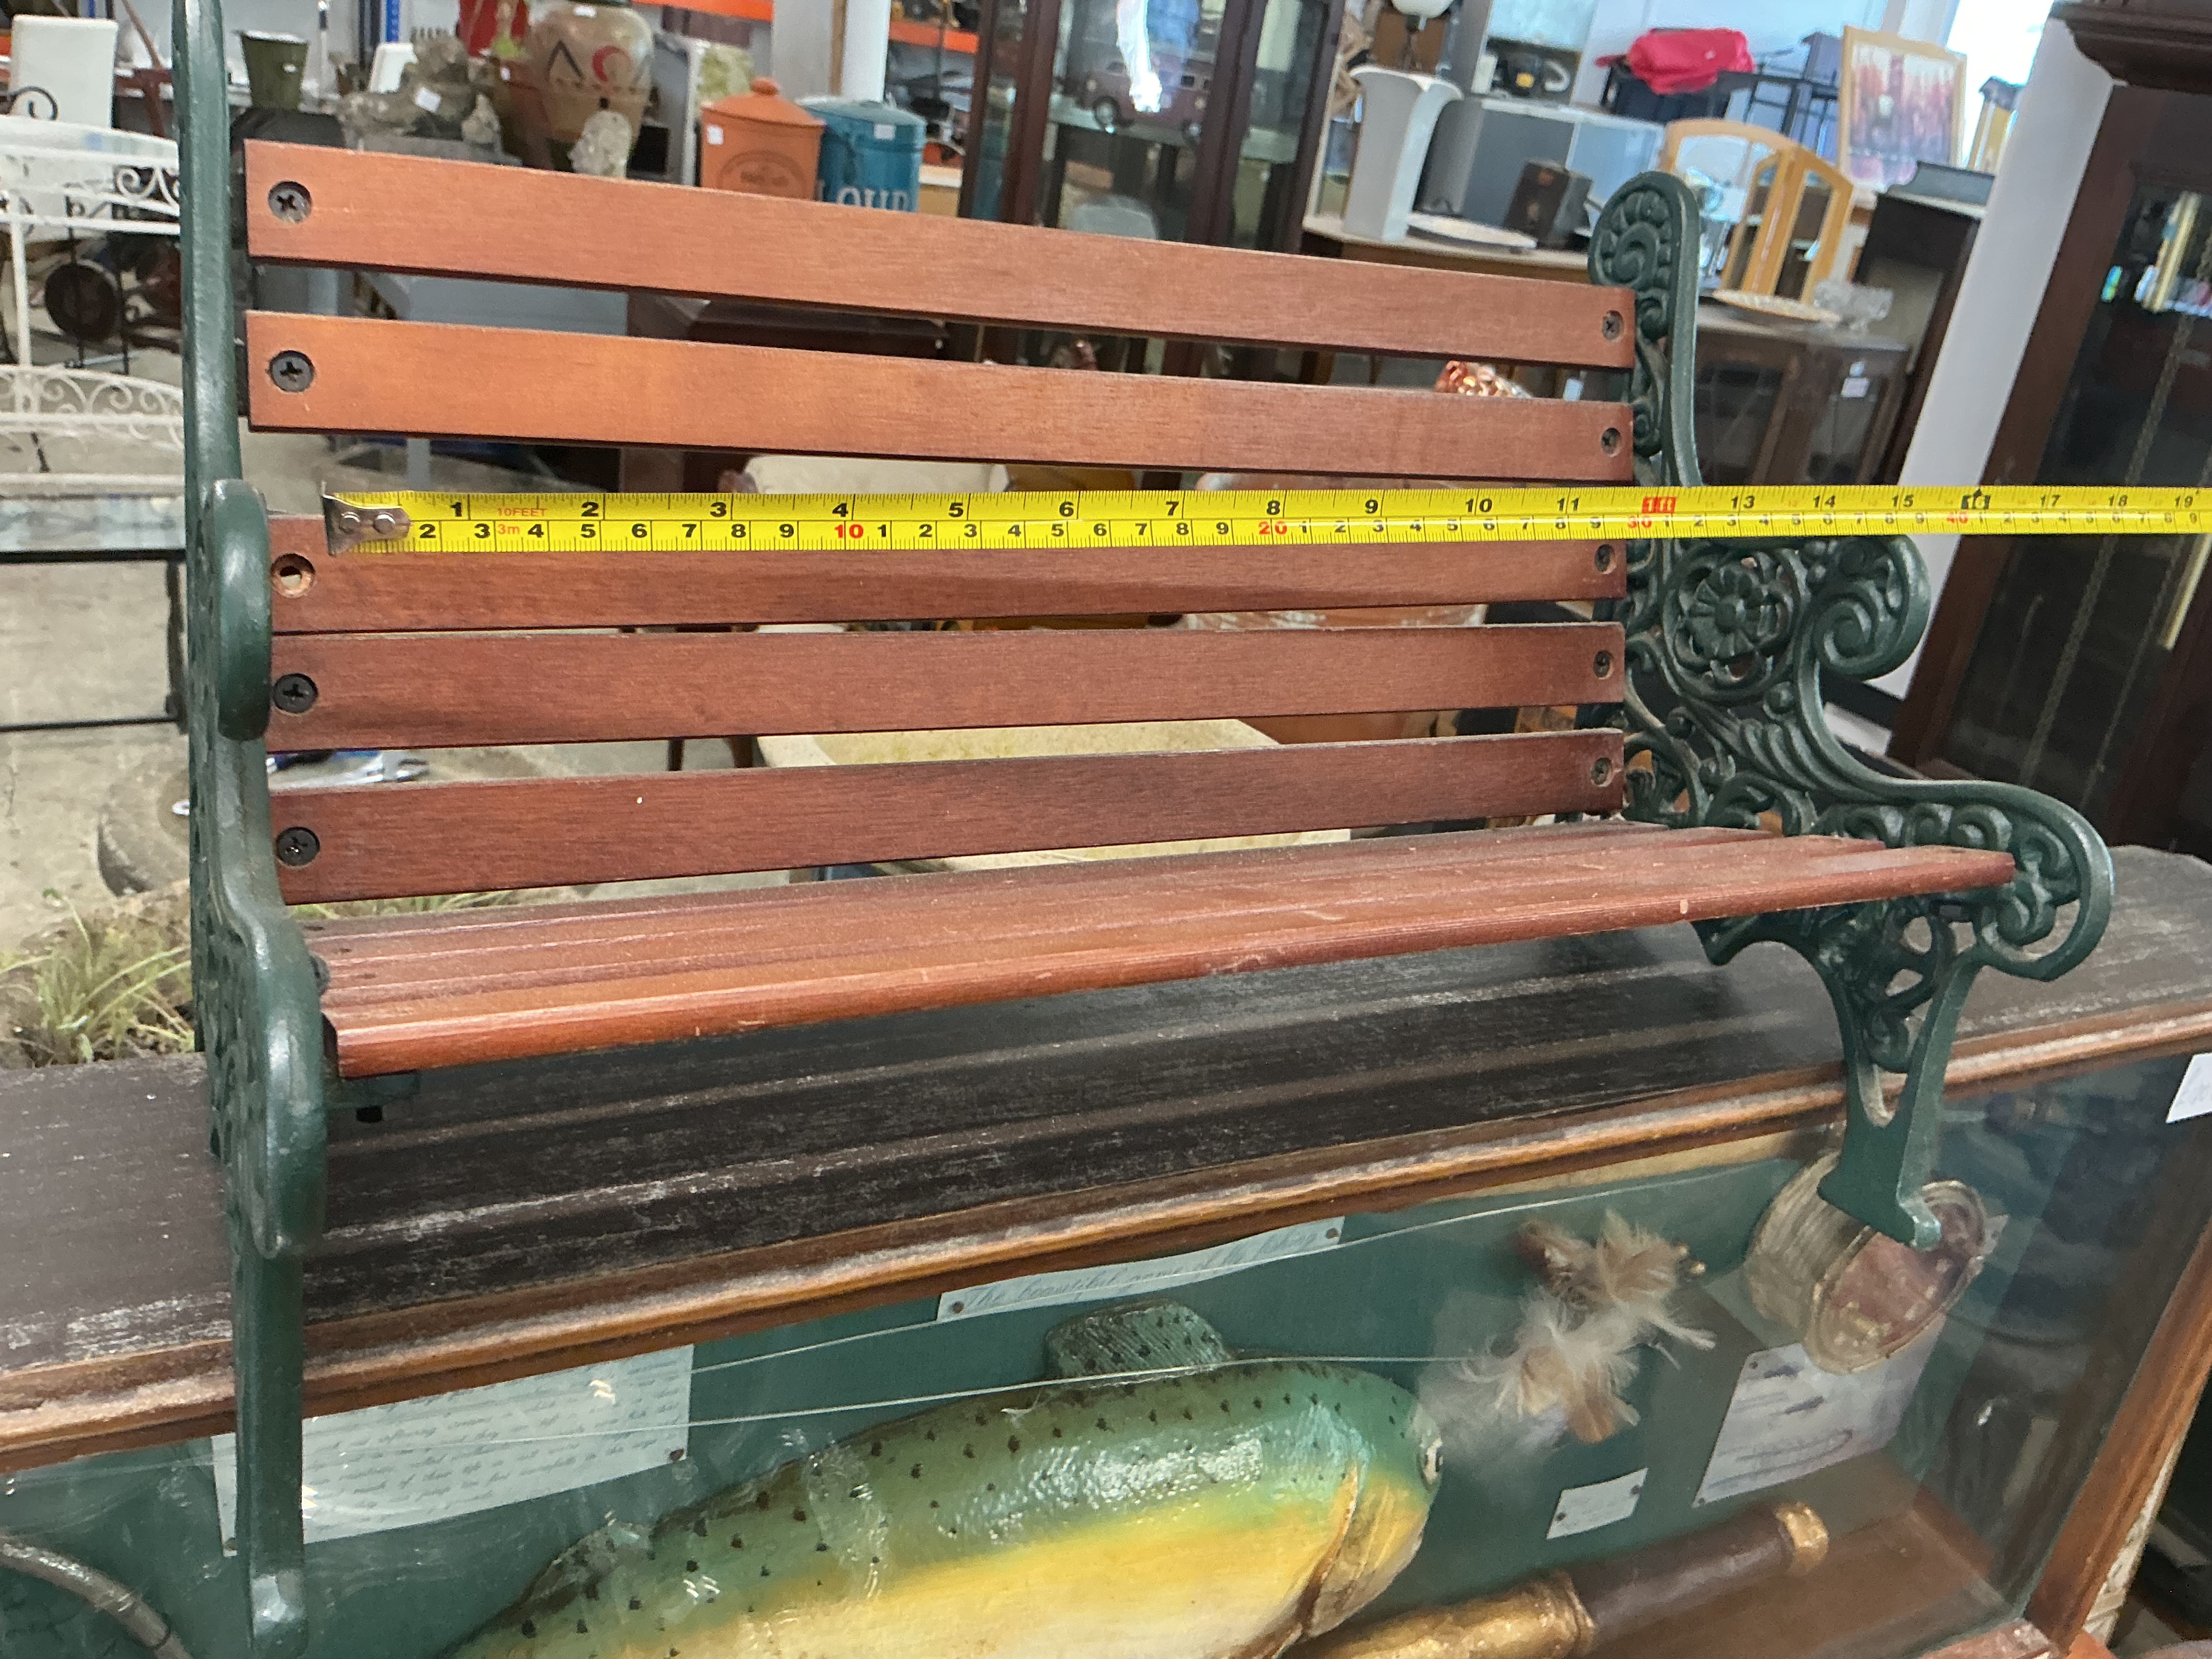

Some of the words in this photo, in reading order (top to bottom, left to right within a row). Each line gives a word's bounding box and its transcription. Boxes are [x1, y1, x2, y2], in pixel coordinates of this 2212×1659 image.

[450, 501, 462, 517] 1
[580, 501, 599, 517] 2
[709, 501, 727, 517] 3
[832, 502, 849, 517] 4
[948, 502, 964, 518] 5
[1059, 501, 1074, 517] 6
[1165, 500, 1180, 516] 7
[1266, 500, 1280, 515] 8
[1364, 499, 1379, 514] 9
[1465, 498, 1493, 514] 10
[1556, 497, 1580, 512] 11
[1730, 495, 1755, 509] 13
[1813, 494, 1836, 508] 14
[1892, 494, 1914, 508] 15
[2040, 494, 2062, 507] 17
[2108, 494, 2128, 507] 18
[2175, 495, 2194, 508] 19
[497, 507, 548, 517] 10FEET
[419, 523, 436, 538] 2
[474, 523, 490, 538] 3
[527, 523, 544, 538] 4
[580, 523, 596, 538] 5
[631, 523, 648, 538] 6
[681, 523, 697, 538] 7
[731, 523, 747, 538] 8
[779, 523, 794, 538] 9
[834, 523, 864, 539] 10
[877, 524, 887, 538] 1
[918, 524, 933, 538] 2
[963, 523, 978, 538] 3
[1007, 524, 1022, 537] 4
[1051, 523, 1064, 537] 5
[1093, 523, 1107, 536] 6
[1135, 523, 1148, 536] 7
[1176, 522, 1189, 535] 8
[1216, 522, 1229, 535] 9
[1258, 521, 1288, 535] 20
[1298, 521, 1307, 534] 1
[1334, 520, 1346, 533] 2
[1372, 520, 1384, 532] 3
[1409, 519, 1422, 532] 4
[1447, 518, 1458, 531] 5
[1482, 517, 1495, 531] 6
[1520, 517, 1529, 530] 7
[1555, 517, 1567, 529] 8
[1589, 516, 1601, 529] 9
[1627, 515, 1652, 529] 30
[1662, 515, 1670, 527] 1
[1692, 514, 1703, 527] 2
[1725, 514, 1737, 527] 3
[1758, 513, 1769, 526] 4
[1791, 512, 1802, 526] 5
[1822, 511, 1833, 525] 6
[1854, 511, 1864, 524] 7
[1884, 511, 1895, 524] 8
[1915, 510, 1925, 524] 9
[1946, 510, 1969, 524] 40
[1978, 510, 1984, 523] 1
[2003, 510, 2013, 524] 2
[2030, 511, 2040, 524] 3
[2058, 510, 2069, 524] 4
[2085, 510, 2094, 523] 5
[2112, 511, 2121, 524] 6
[2138, 510, 2147, 523] 7
[2163, 510, 2173, 523] 8
[2189, 510, 2198, 523] 9
[497, 523, 521, 535] 3m
[965, 1284, 1007, 1307] The
